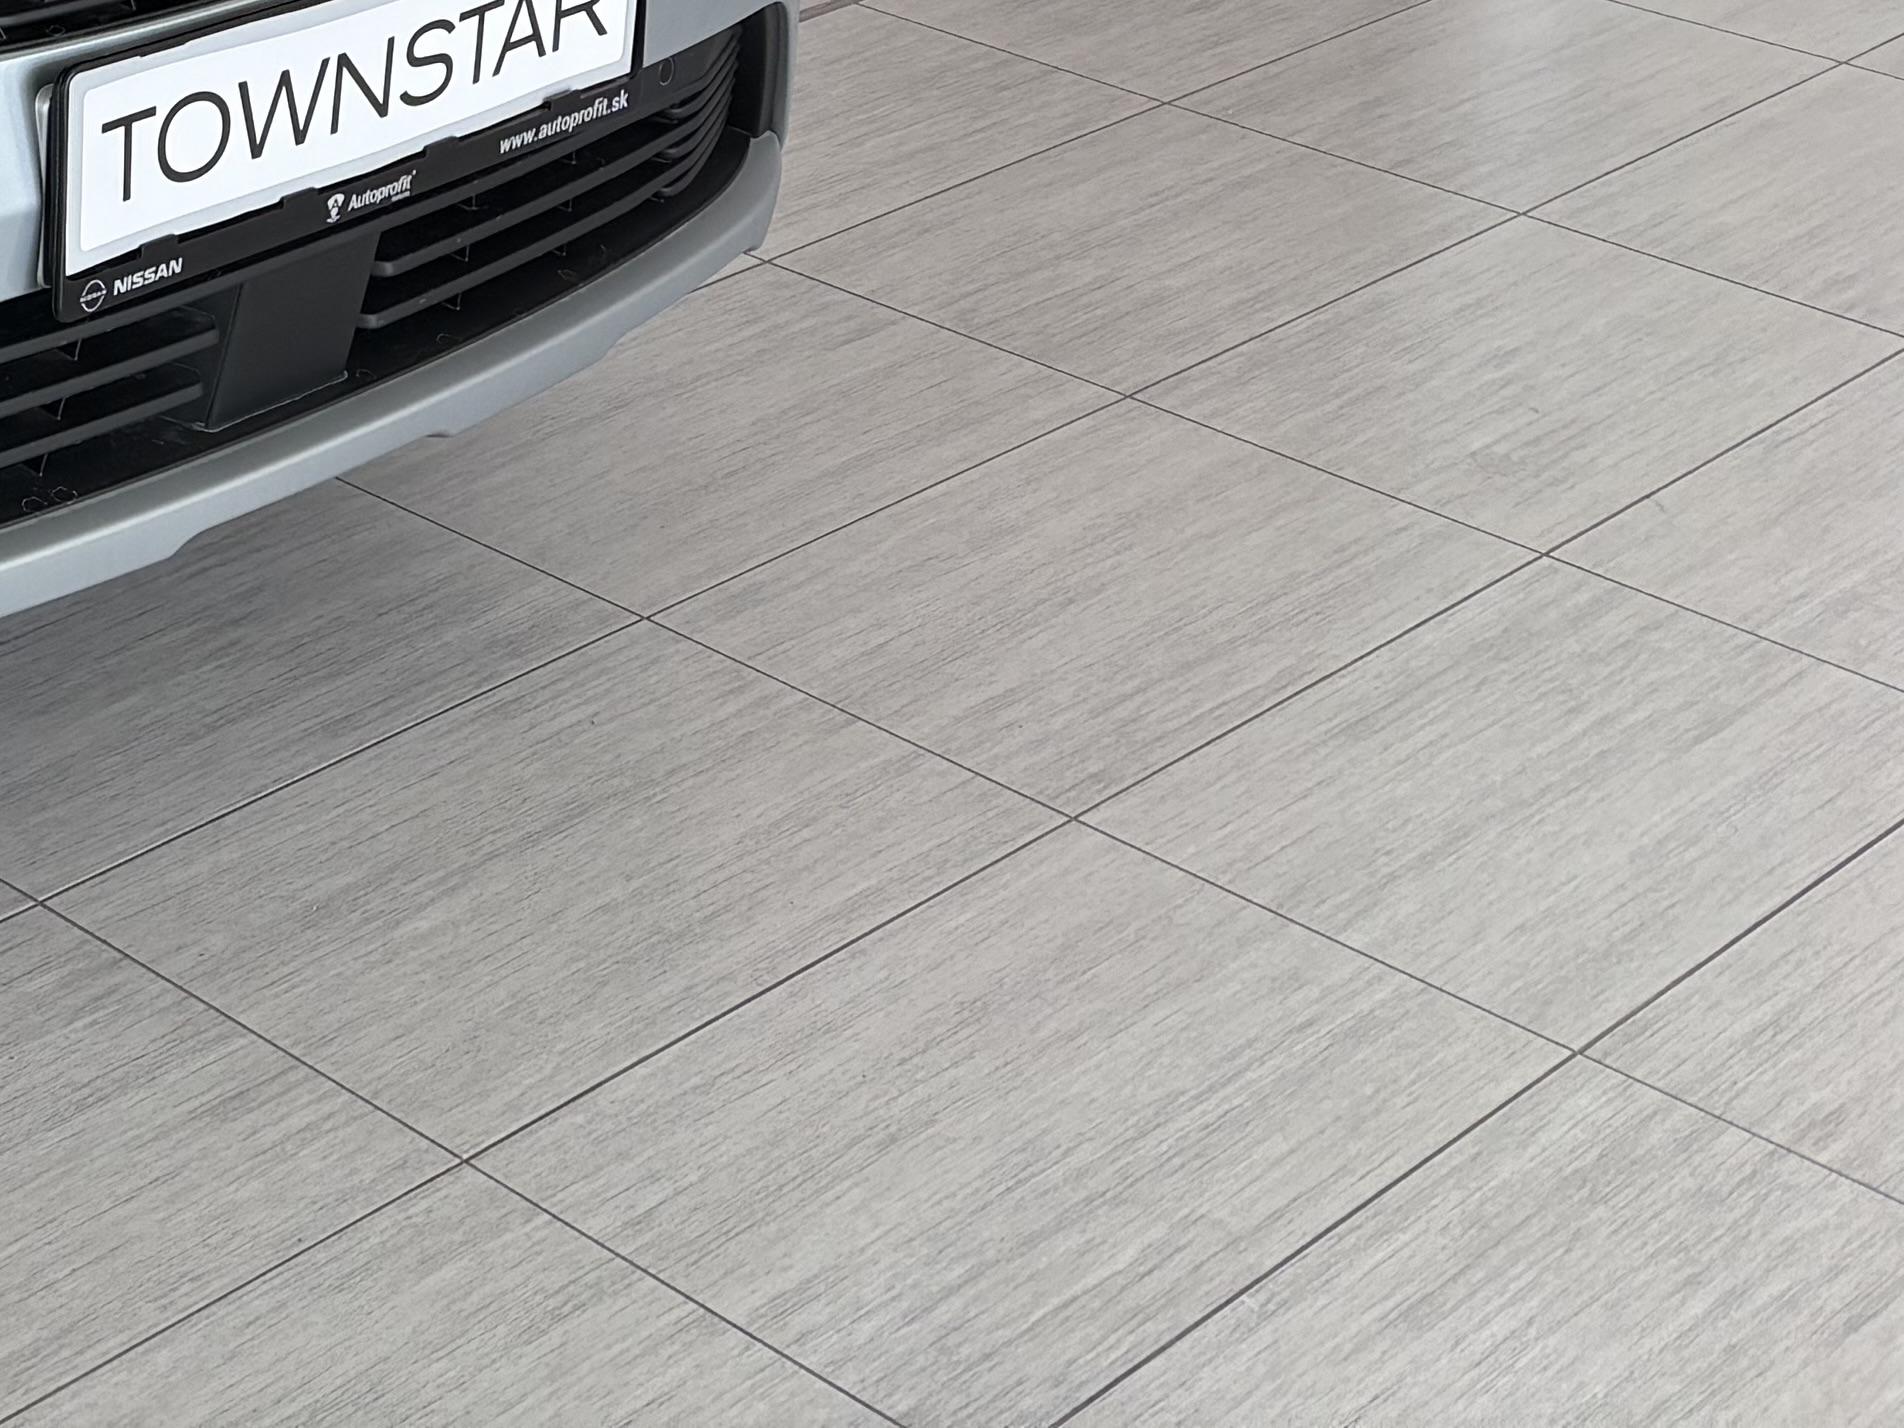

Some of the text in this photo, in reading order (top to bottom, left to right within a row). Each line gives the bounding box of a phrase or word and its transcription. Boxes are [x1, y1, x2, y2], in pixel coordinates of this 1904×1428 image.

[499, 89, 629, 154] www.autoprofit.sk
[347, 174, 413, 212] Autoprofit
[113, 257, 183, 296] NISSAN
